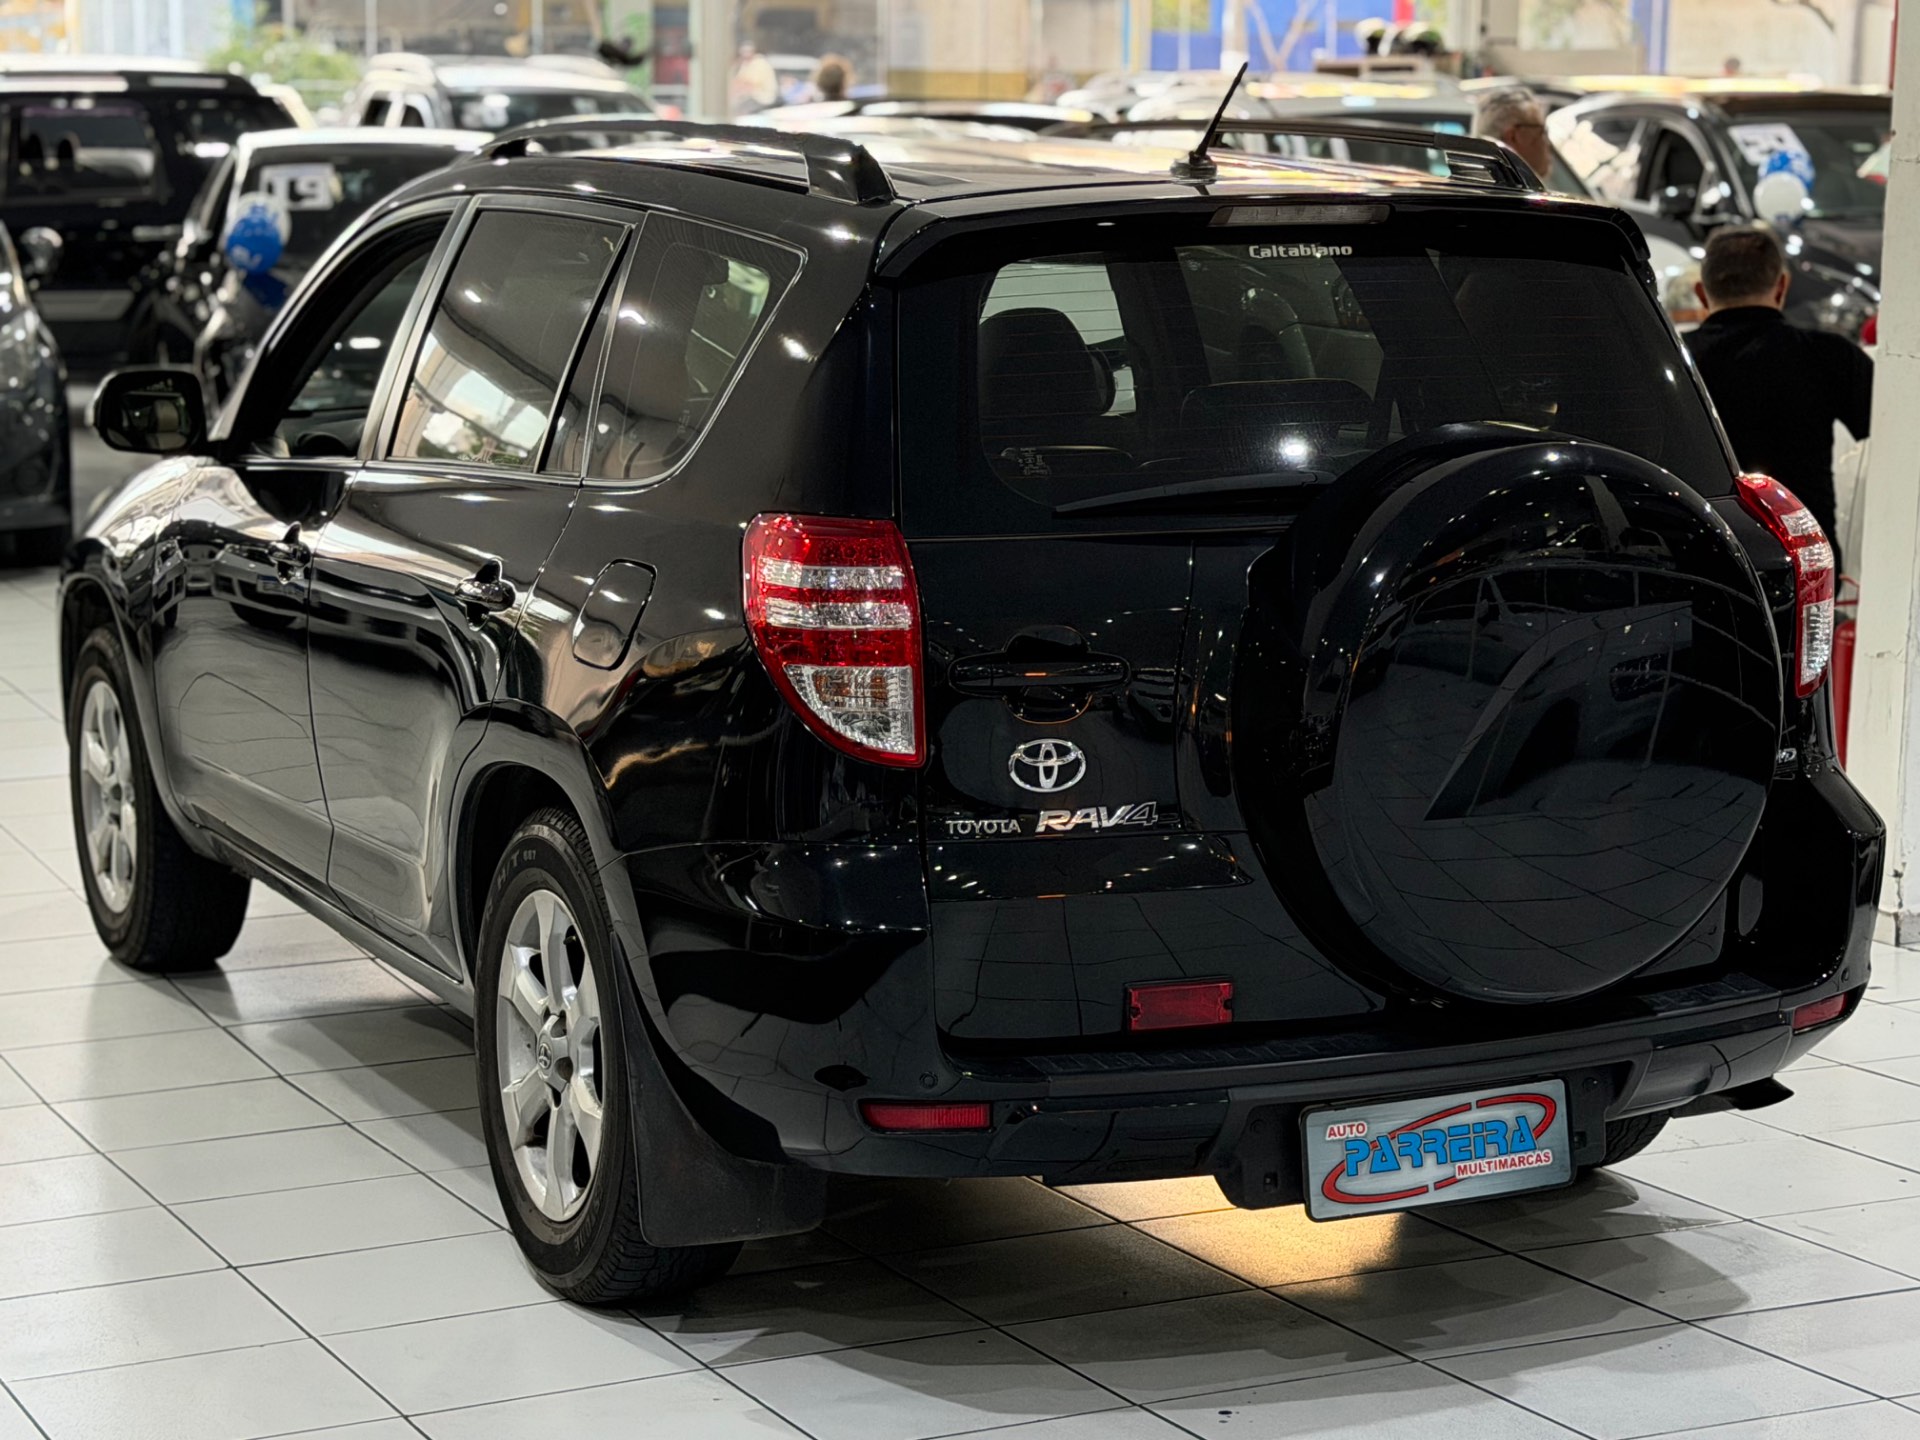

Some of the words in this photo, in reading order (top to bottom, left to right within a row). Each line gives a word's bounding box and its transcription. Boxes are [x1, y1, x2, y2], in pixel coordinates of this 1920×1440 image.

[1249, 244, 1353, 258] Caltabiano
[946, 819, 1021, 834] TOYOTA
[1035, 801, 1158, 832] RAV4
[1327, 1122, 1366, 1138] AUTO
[1345, 1115, 1537, 1177] PARREIRA
[1457, 1151, 1551, 1176] MULTIMARCAS
